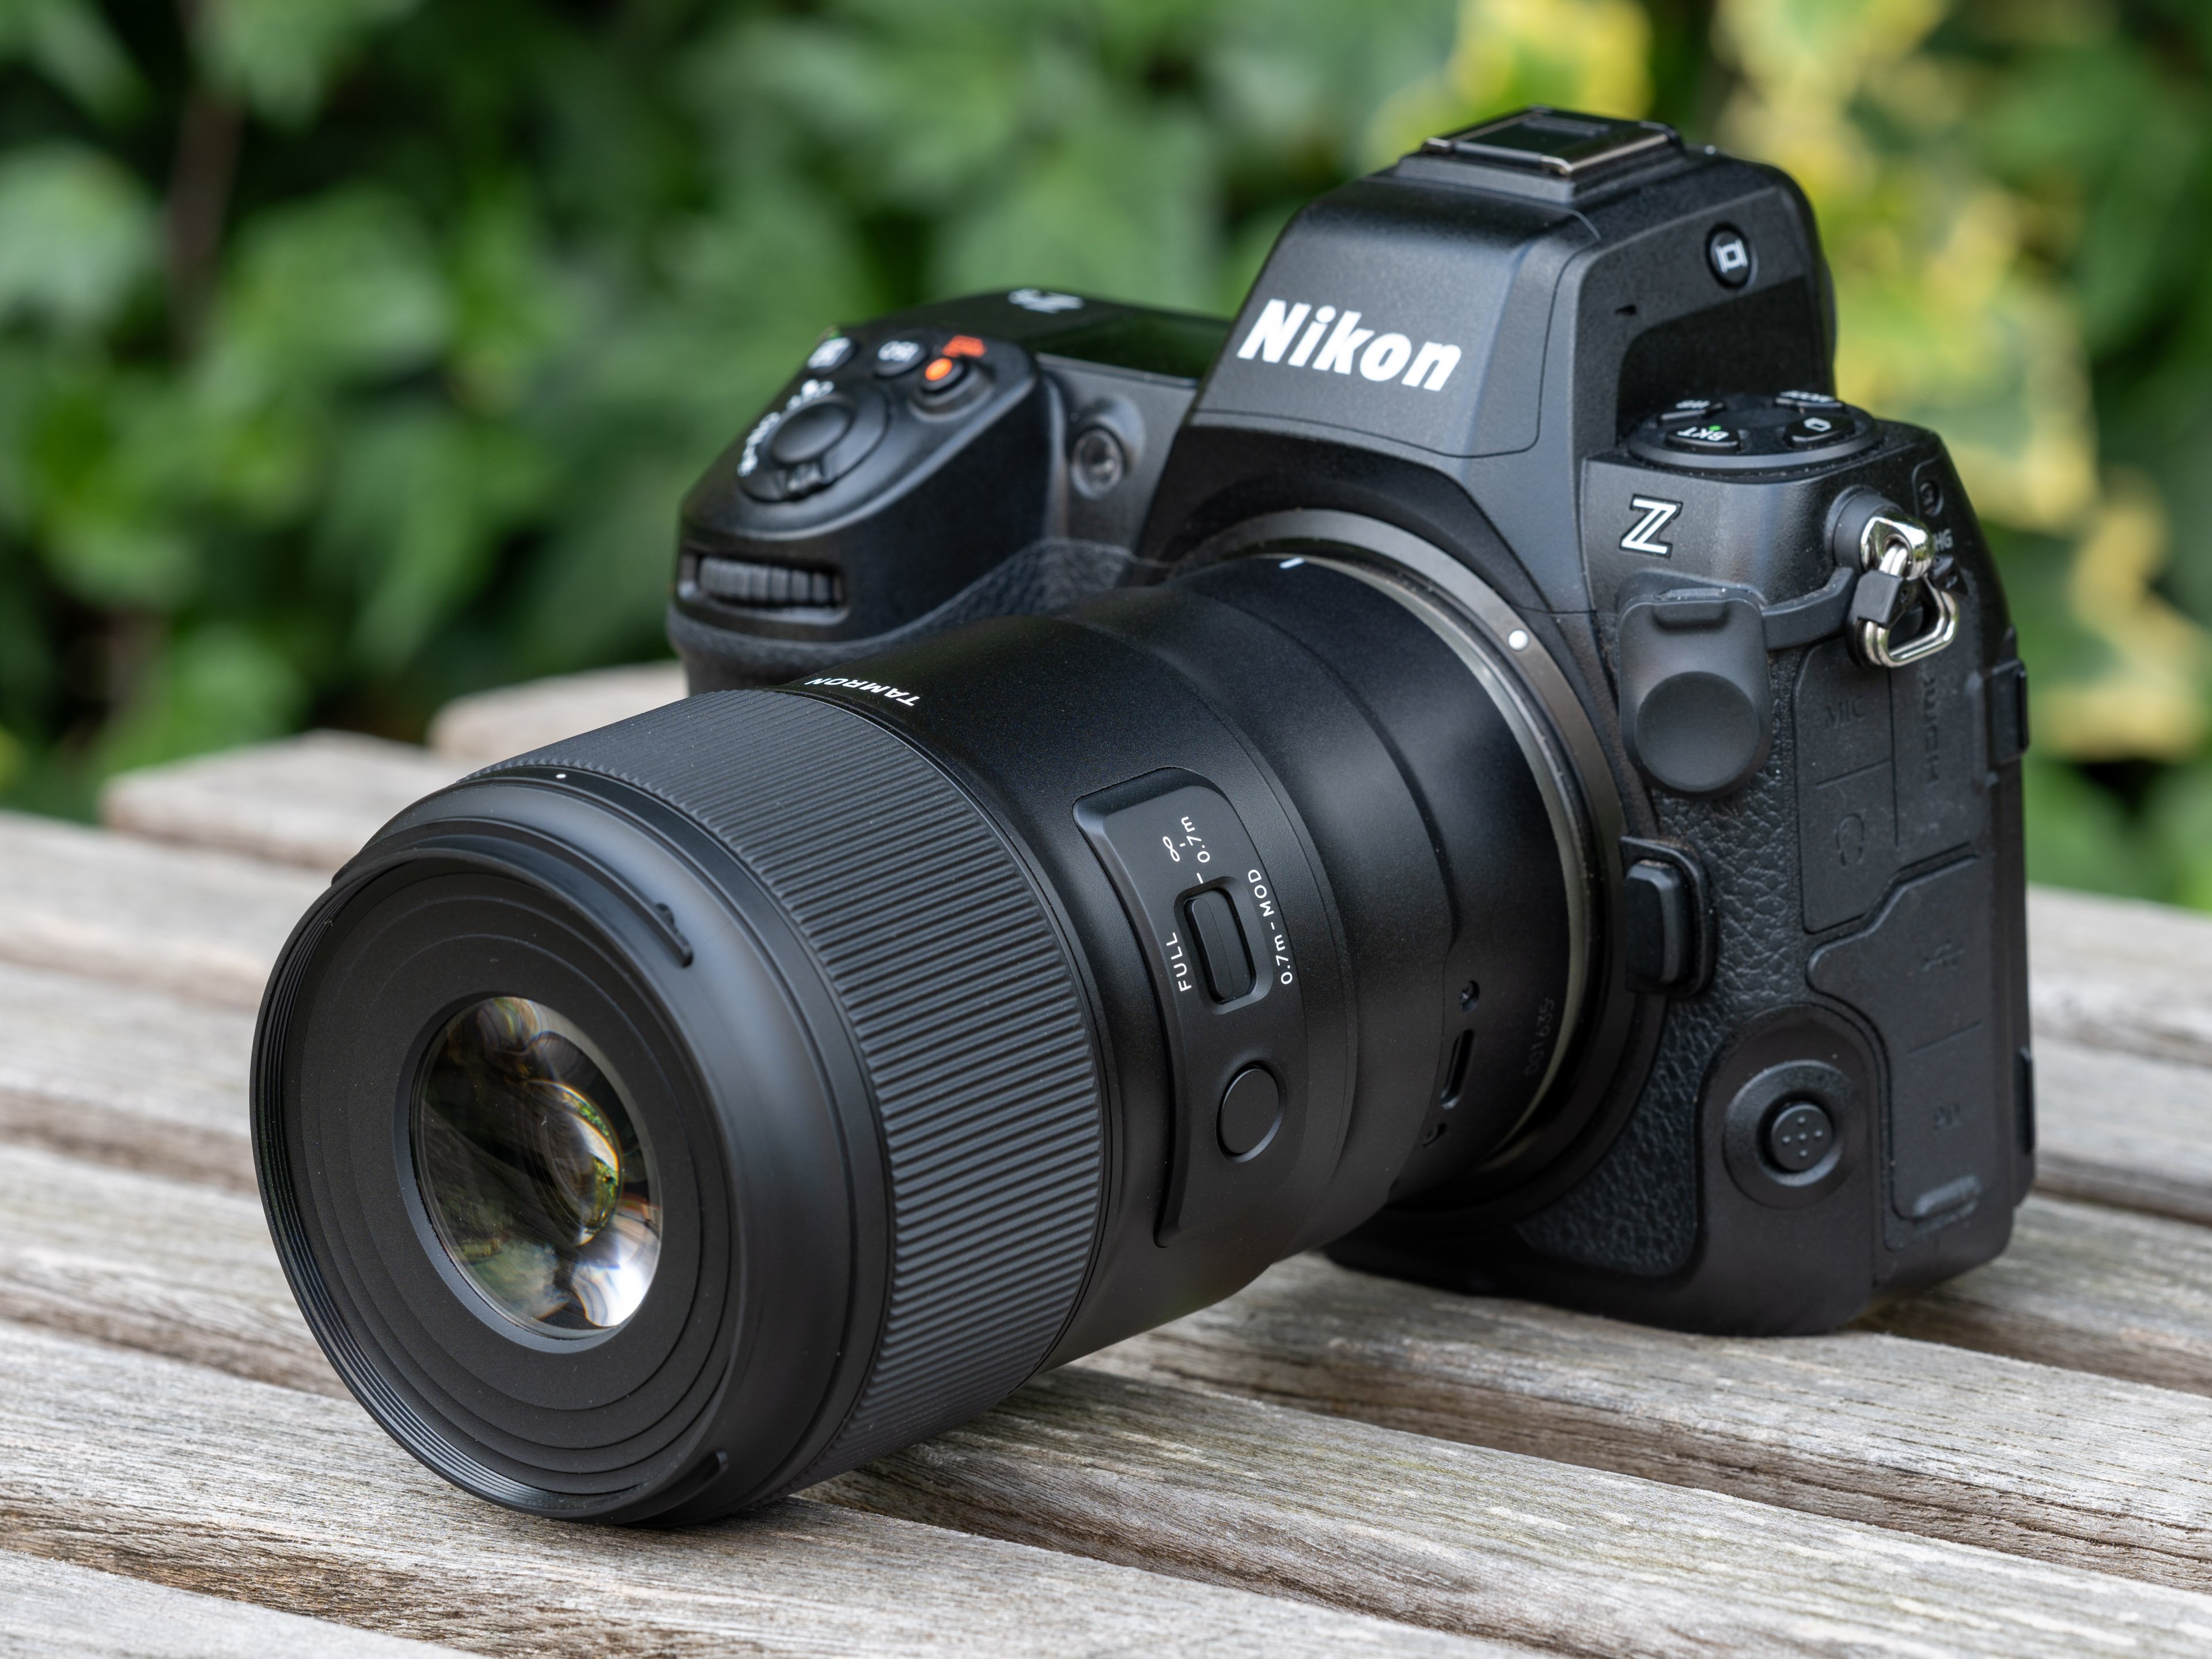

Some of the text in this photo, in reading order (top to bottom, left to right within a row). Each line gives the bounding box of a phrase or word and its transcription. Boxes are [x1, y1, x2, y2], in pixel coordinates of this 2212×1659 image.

[1238, 300, 1461, 391] Nikon
[1677, 426, 1729, 441] BKT
[1620, 498, 1679, 555] Z
[1933, 528, 1953, 553] HG
[804, 678, 921, 706] TAMRON
[1824, 695, 1866, 728] MIC
[1166, 932, 1192, 992] FULL
